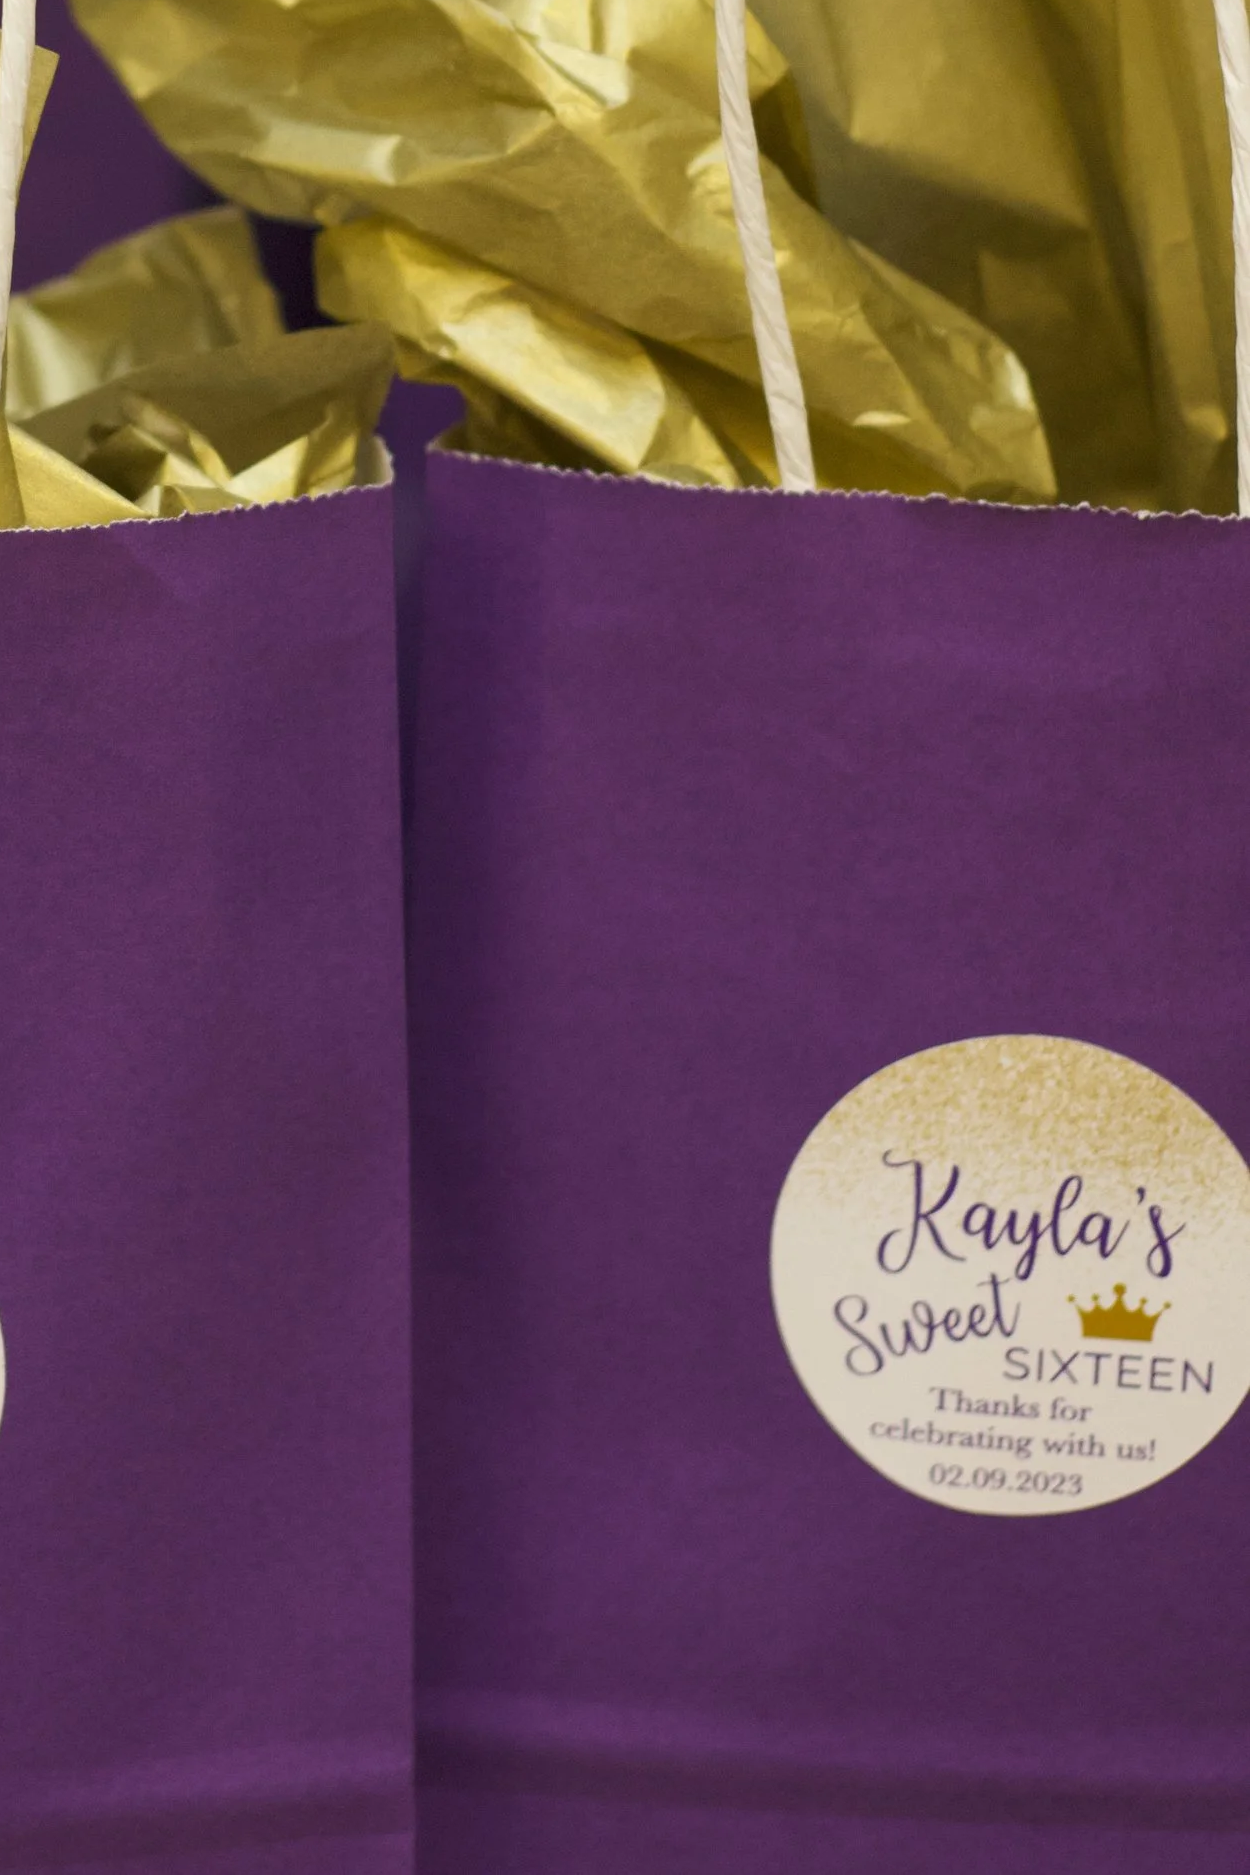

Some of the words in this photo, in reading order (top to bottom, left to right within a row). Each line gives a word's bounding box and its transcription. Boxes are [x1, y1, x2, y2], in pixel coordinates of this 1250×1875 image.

[876, 1149, 1186, 1283] Kayla's
[833, 1272, 1021, 1377] Sweet
[1002, 1346, 1215, 1395] SIXTEEN
[929, 1386, 1041, 1421] Thanks
[1049, 1396, 1093, 1424] for
[869, 1418, 1034, 1460] celebrating
[1042, 1431, 1107, 1459] with
[1117, 1440, 1157, 1462] us!
[929, 1462, 1084, 1497] 02.09.2023
